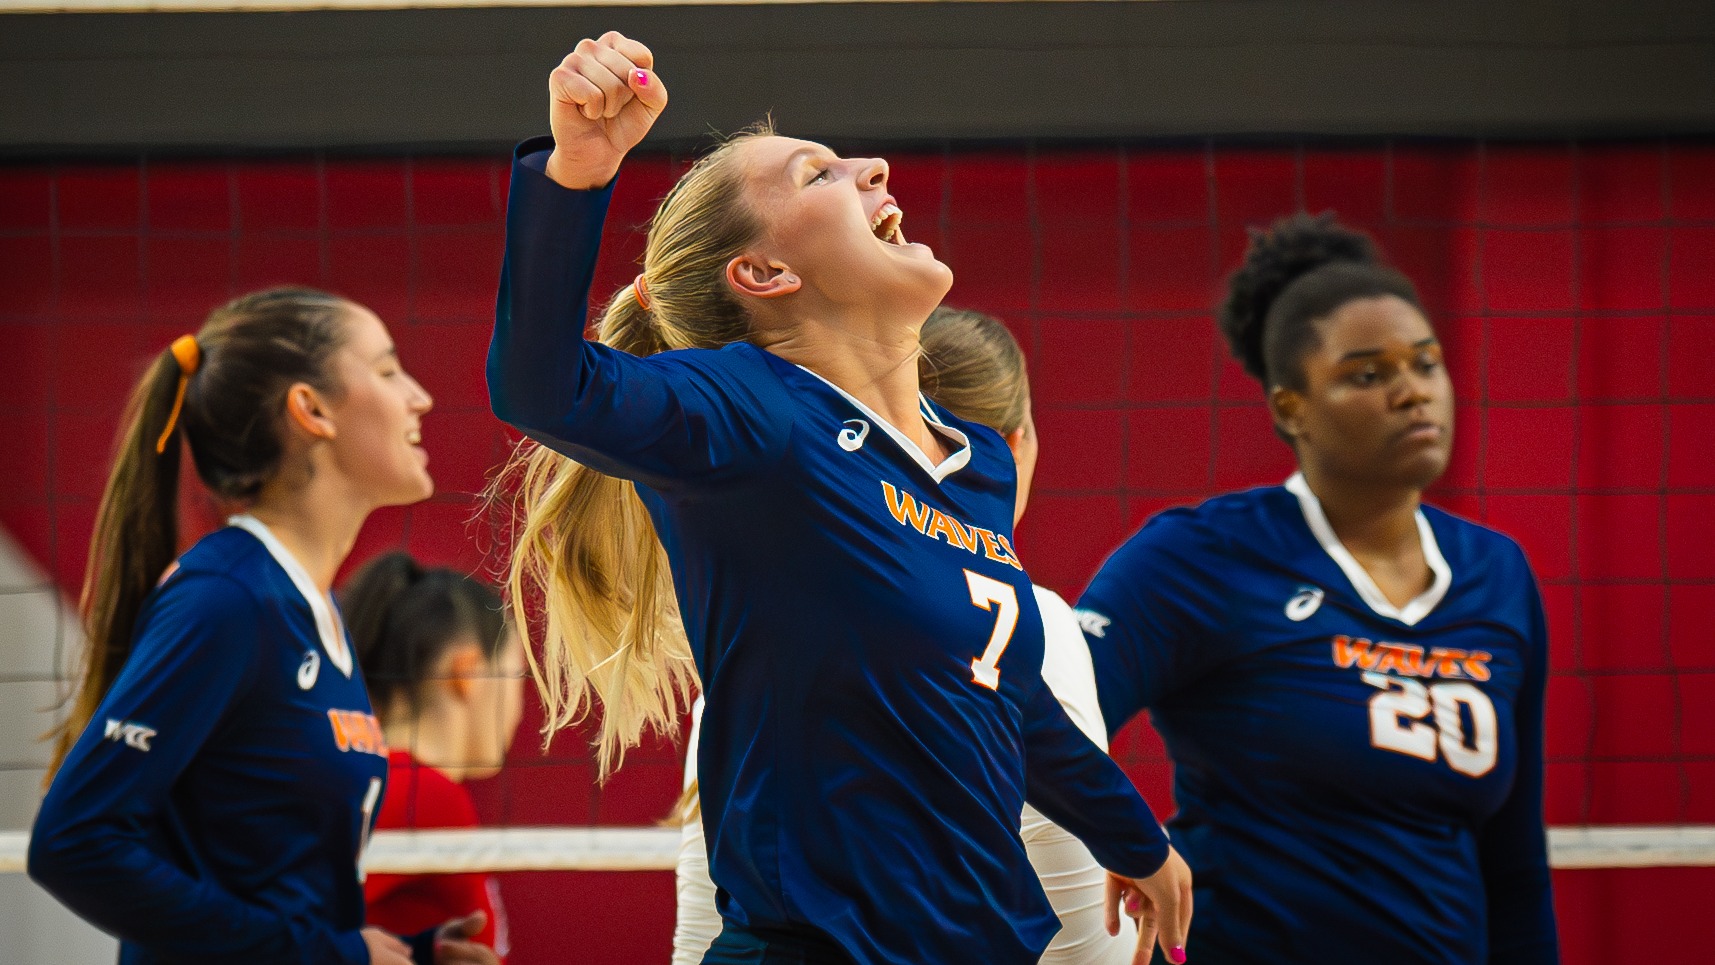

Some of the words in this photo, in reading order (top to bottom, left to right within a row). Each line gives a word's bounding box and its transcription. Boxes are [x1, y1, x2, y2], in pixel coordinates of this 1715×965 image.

[880, 480, 1024, 571] WAVES
[962, 568, 1020, 691] 7
[1331, 634, 1493, 682] WAVES
[1360, 669, 1499, 779] 20
